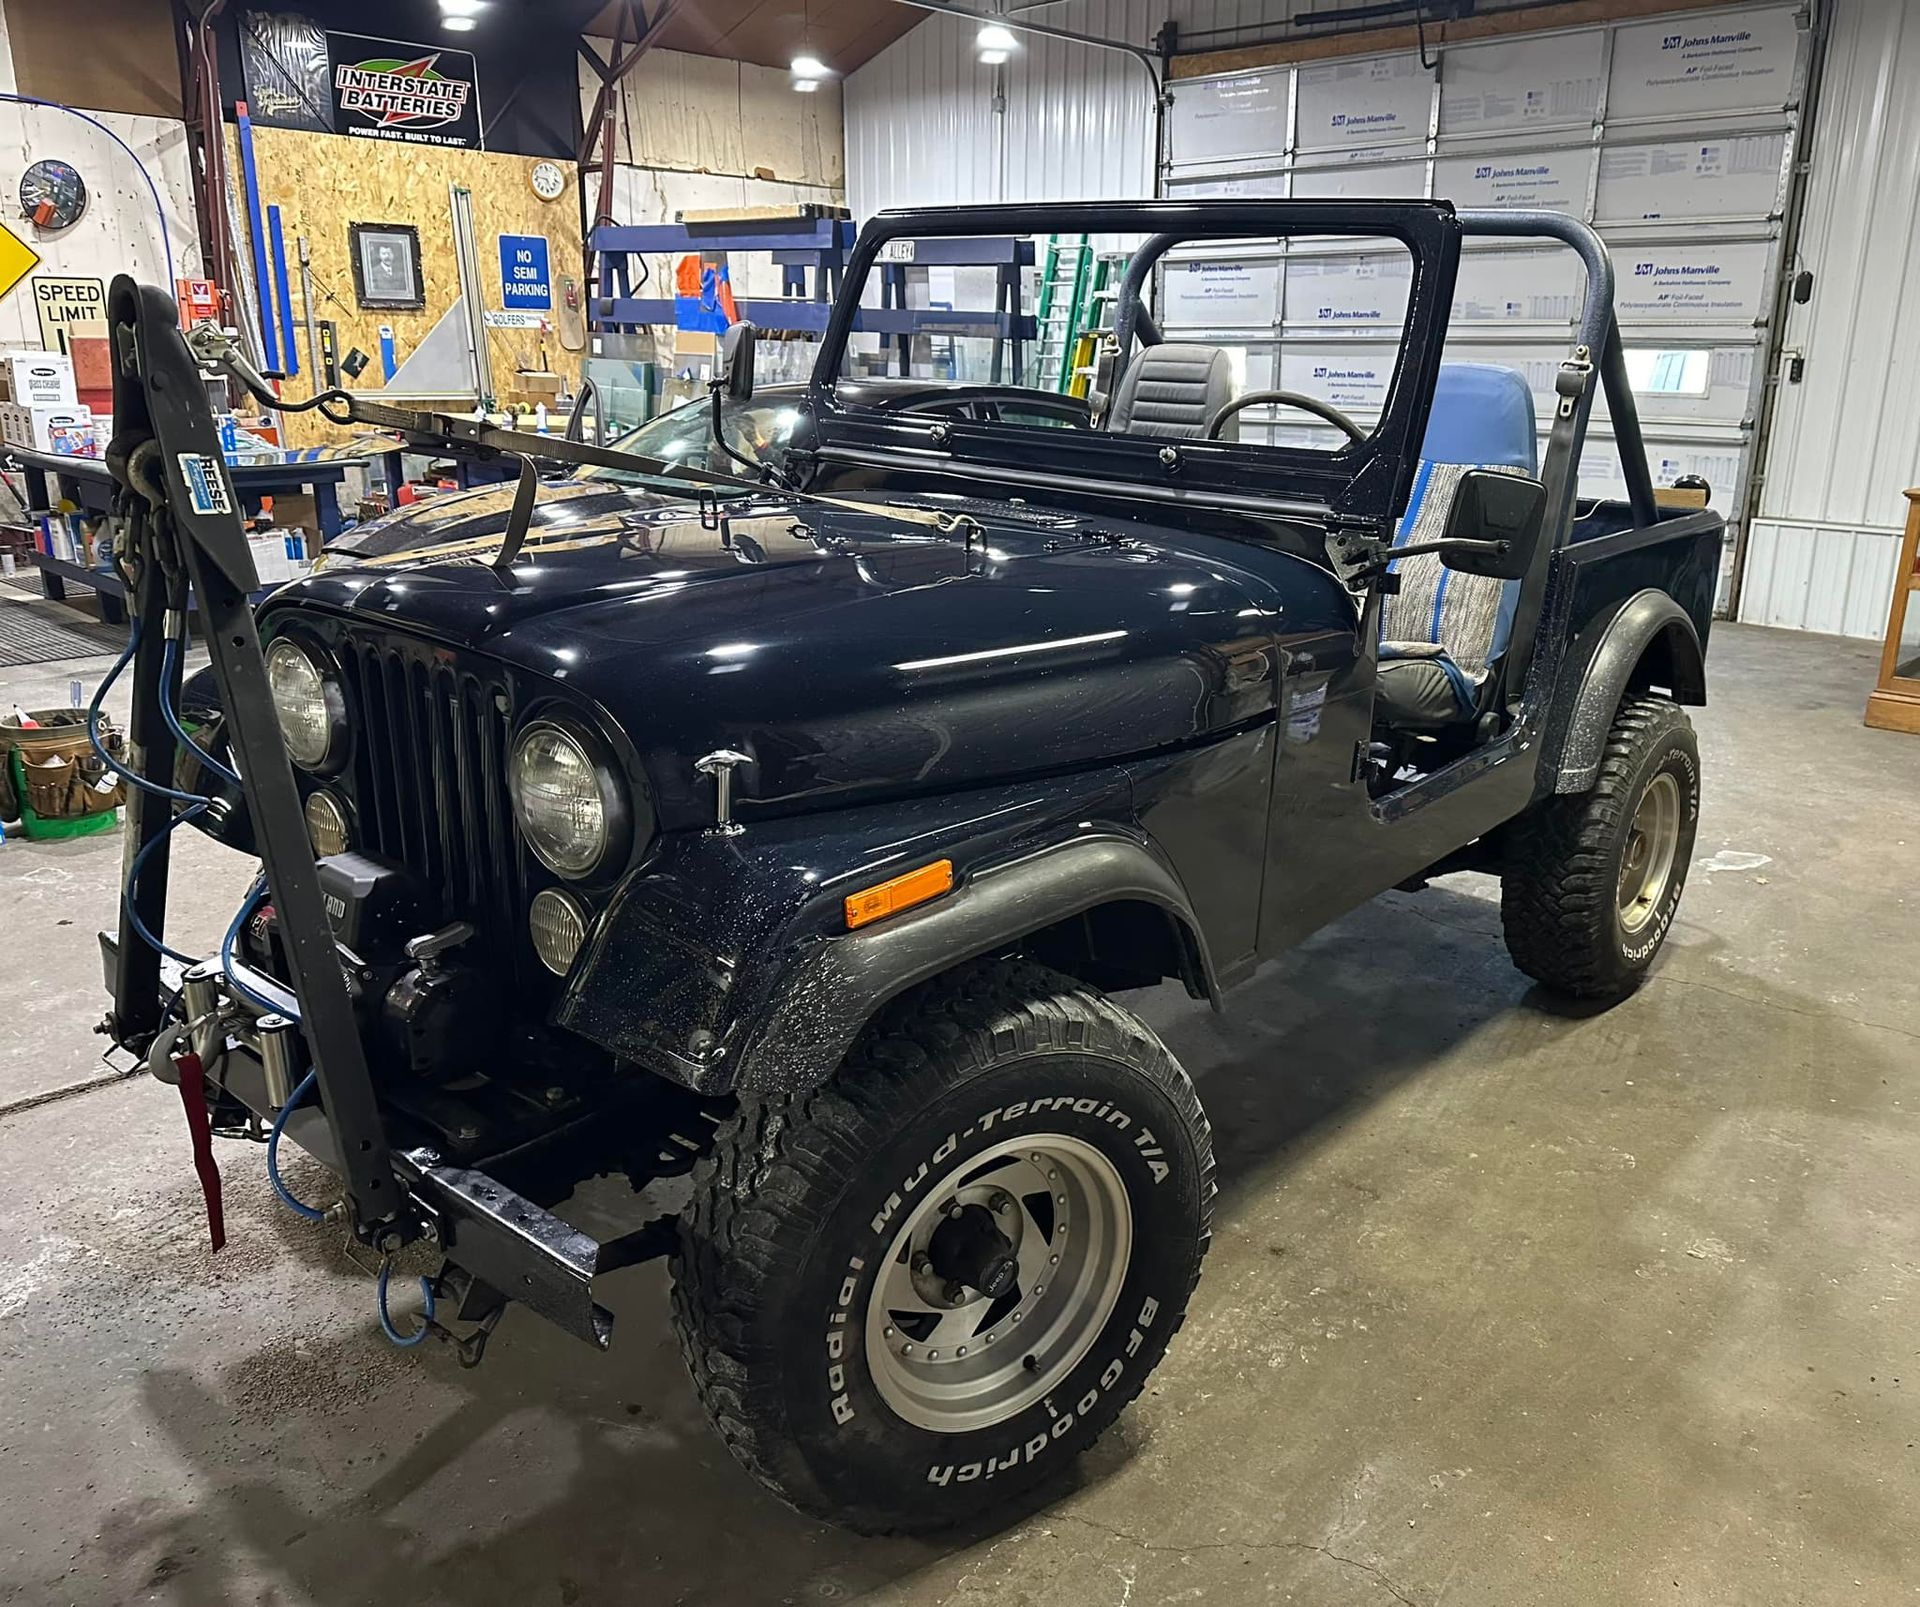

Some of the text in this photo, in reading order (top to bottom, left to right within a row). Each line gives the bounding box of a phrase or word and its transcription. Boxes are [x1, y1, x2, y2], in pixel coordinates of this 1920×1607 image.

[1681, 39, 1709, 49] Johns
[1710, 31, 1751, 44] Manville
[341, 69, 464, 99] INTERSTATE
[346, 89, 459, 117] BATTERIES
[1346, 117, 1366, 126] Johns
[1367, 112, 1396, 123] Manville
[348, 126, 379, 137] POWER
[381, 129, 403, 139] FAST.
[404, 132, 428, 142] BUILT
[430, 135, 442, 144] TO
[1491, 169, 1514, 178] Johns
[1515, 166, 1549, 176] Manville
[516, 249, 532, 263] NO
[513, 266, 537, 280] SEMI
[1653, 266, 1679, 276] Johns
[1681, 265, 1720, 275] Manville
[38, 284, 100, 302] SPEED
[505, 283, 548, 297] PARKING
[47, 306, 97, 322] LIMIT
[492, 314, 525, 326] GOLFERS
[1332, 311, 1351, 319] Johns
[1352, 310, 1381, 318] Manville
[1327, 371, 1346, 379] Johns
[199, 458, 226, 511] REESE
[1133, 1126, 1170, 1185] T/A
[870, 1096, 1132, 1235] Mud-Terrain
[989, 1272, 1004, 1292] Jeep
[826, 1256, 864, 1426] Radial
